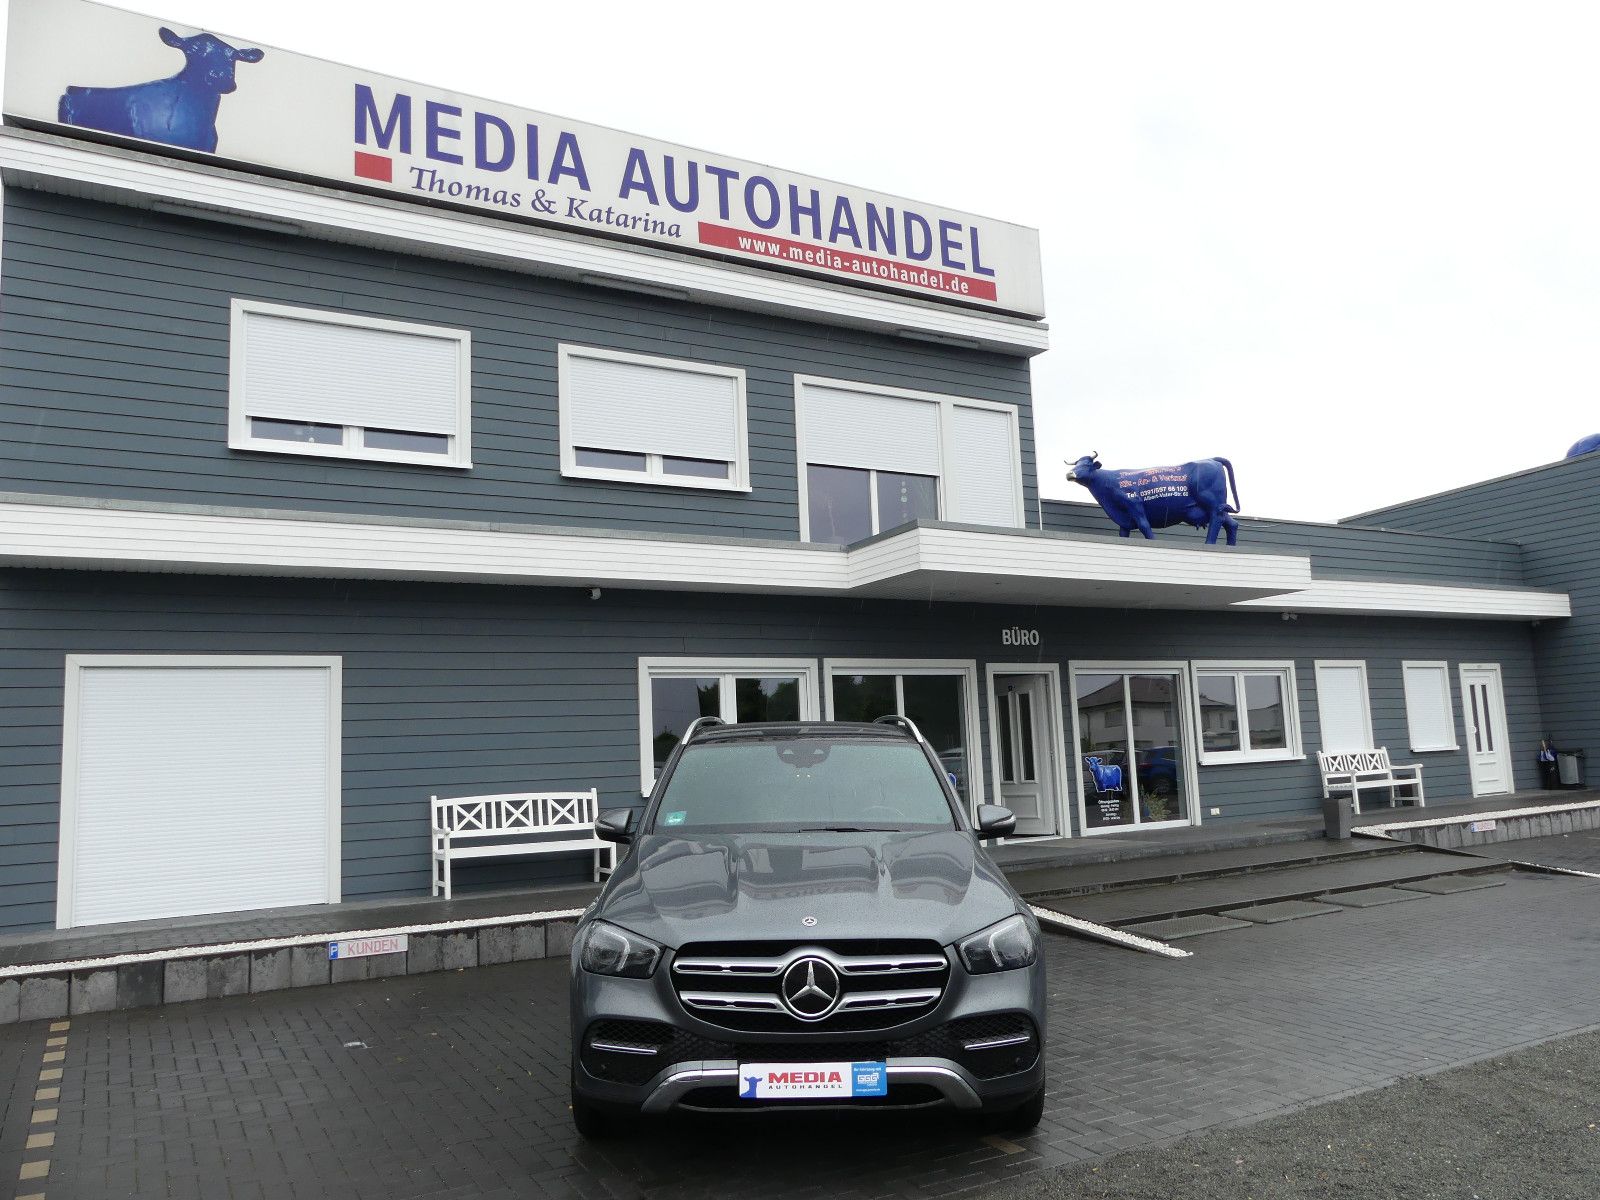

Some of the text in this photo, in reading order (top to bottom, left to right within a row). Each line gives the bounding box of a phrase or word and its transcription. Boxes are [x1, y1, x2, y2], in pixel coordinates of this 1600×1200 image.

[354, 83, 996, 277] MEDIA AUTOHANDEL
[409, 166, 682, 239] Thomas & Katarina
[738, 235, 969, 294] www.media-autohandel.de
[1002, 626, 1040, 646] BÜRO
[347, 939, 399, 956] KUNDEN
[768, 1071, 842, 1084] MEDIA
